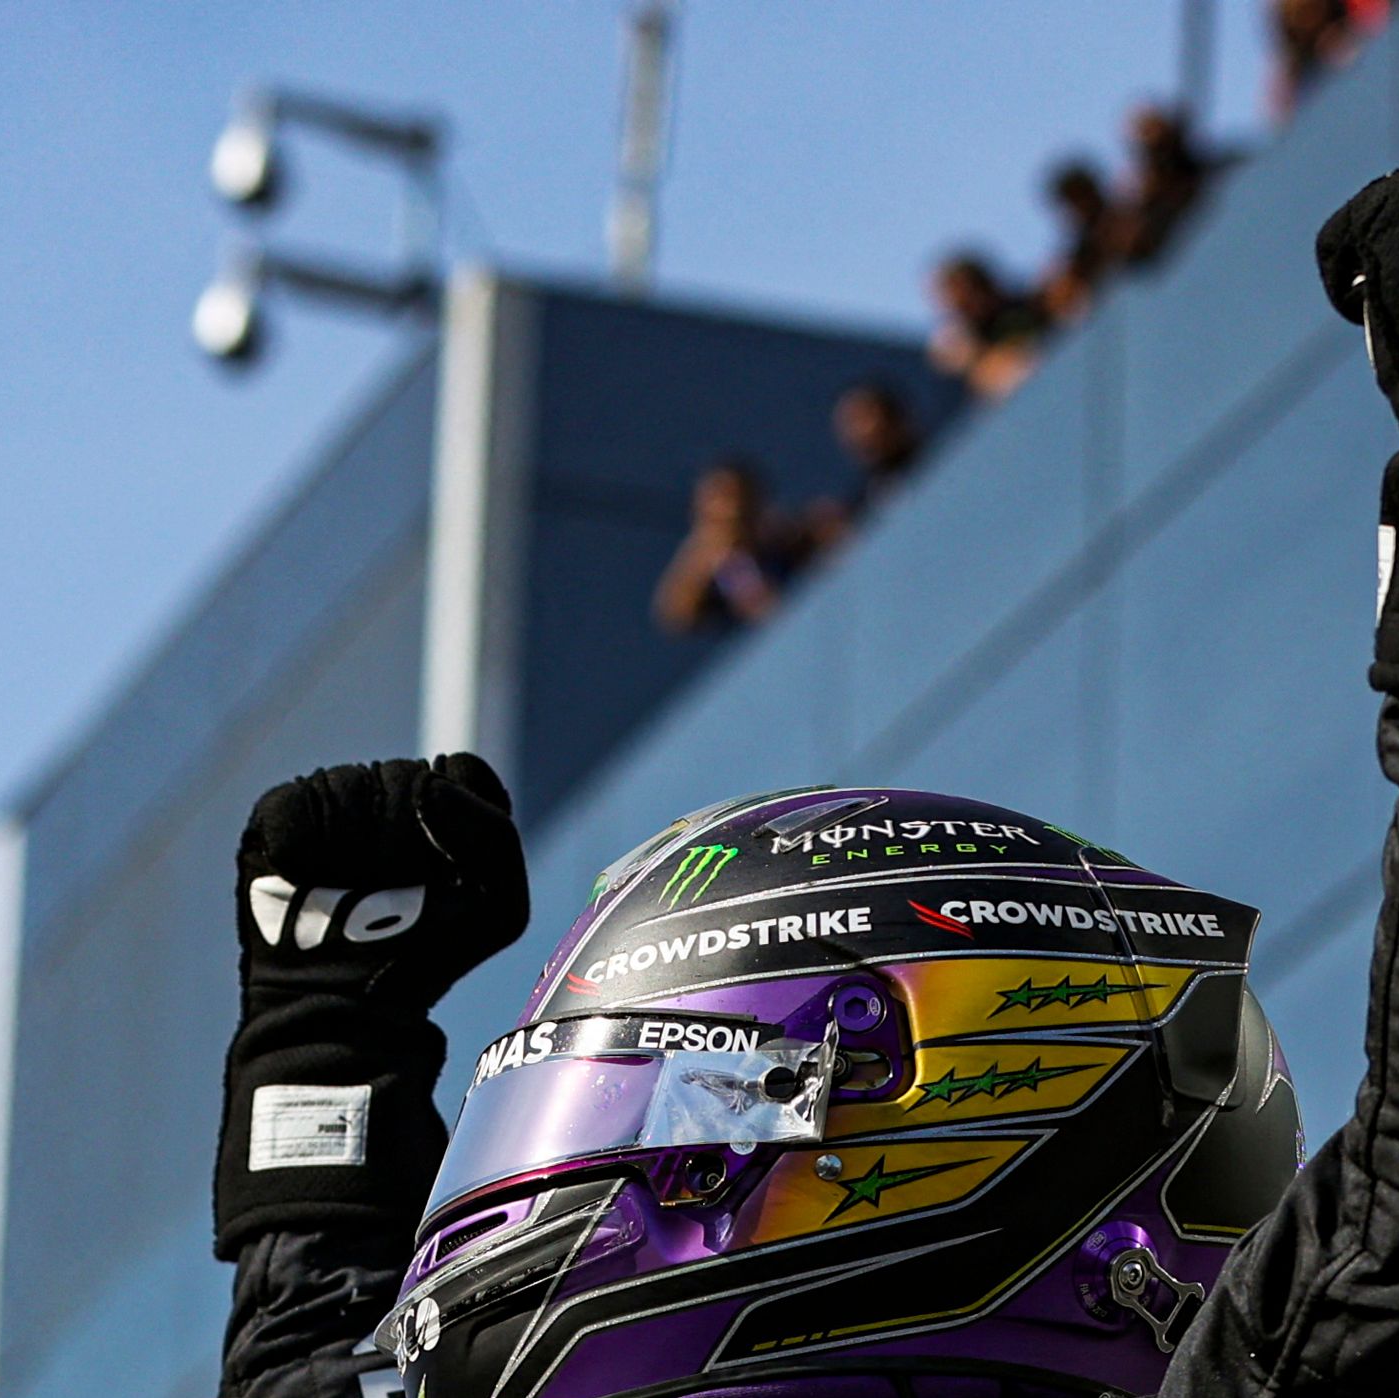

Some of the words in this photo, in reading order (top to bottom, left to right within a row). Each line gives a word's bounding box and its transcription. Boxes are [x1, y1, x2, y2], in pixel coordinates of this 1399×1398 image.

[811, 843, 1008, 866] ENERGY
[939, 900, 1226, 938] CROWDSTRIKE
[584, 906, 872, 984] CROWDSTRIKE
[637, 1021, 760, 1053] EPSON
